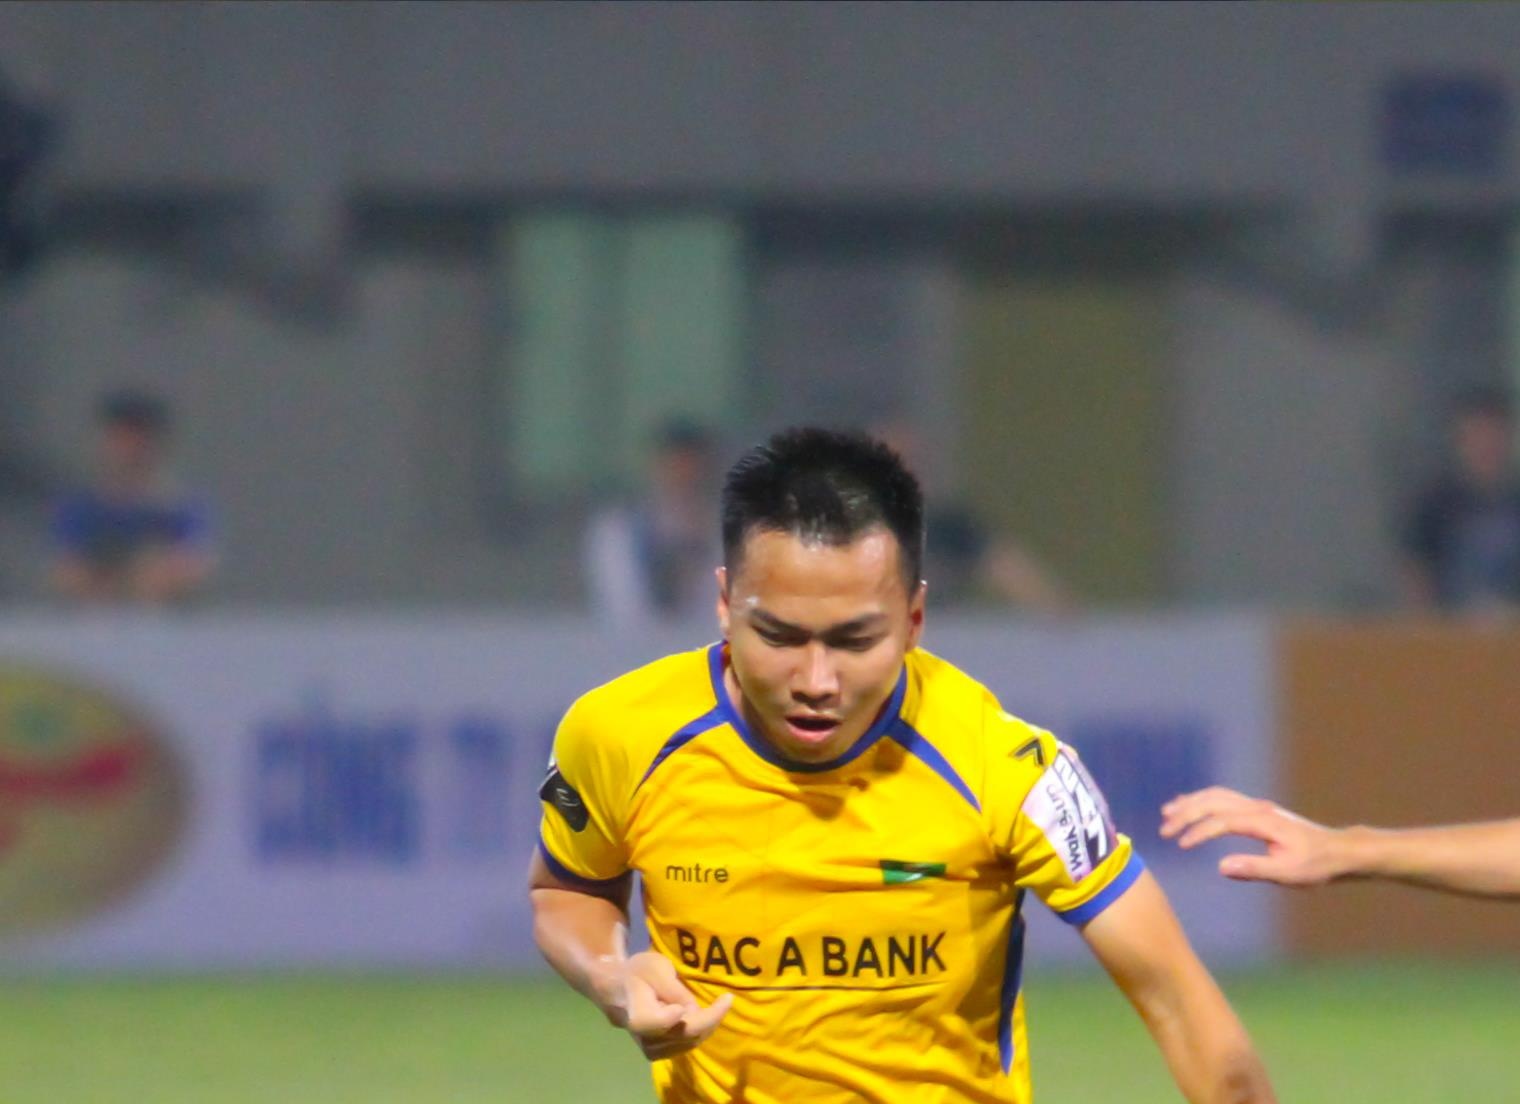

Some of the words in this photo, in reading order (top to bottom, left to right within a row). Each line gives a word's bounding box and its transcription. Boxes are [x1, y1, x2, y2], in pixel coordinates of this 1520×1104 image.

[665, 863, 729, 883] mitre
[676, 928, 763, 977] BAC
[776, 936, 807, 977] A
[822, 931, 947, 978] BANK
